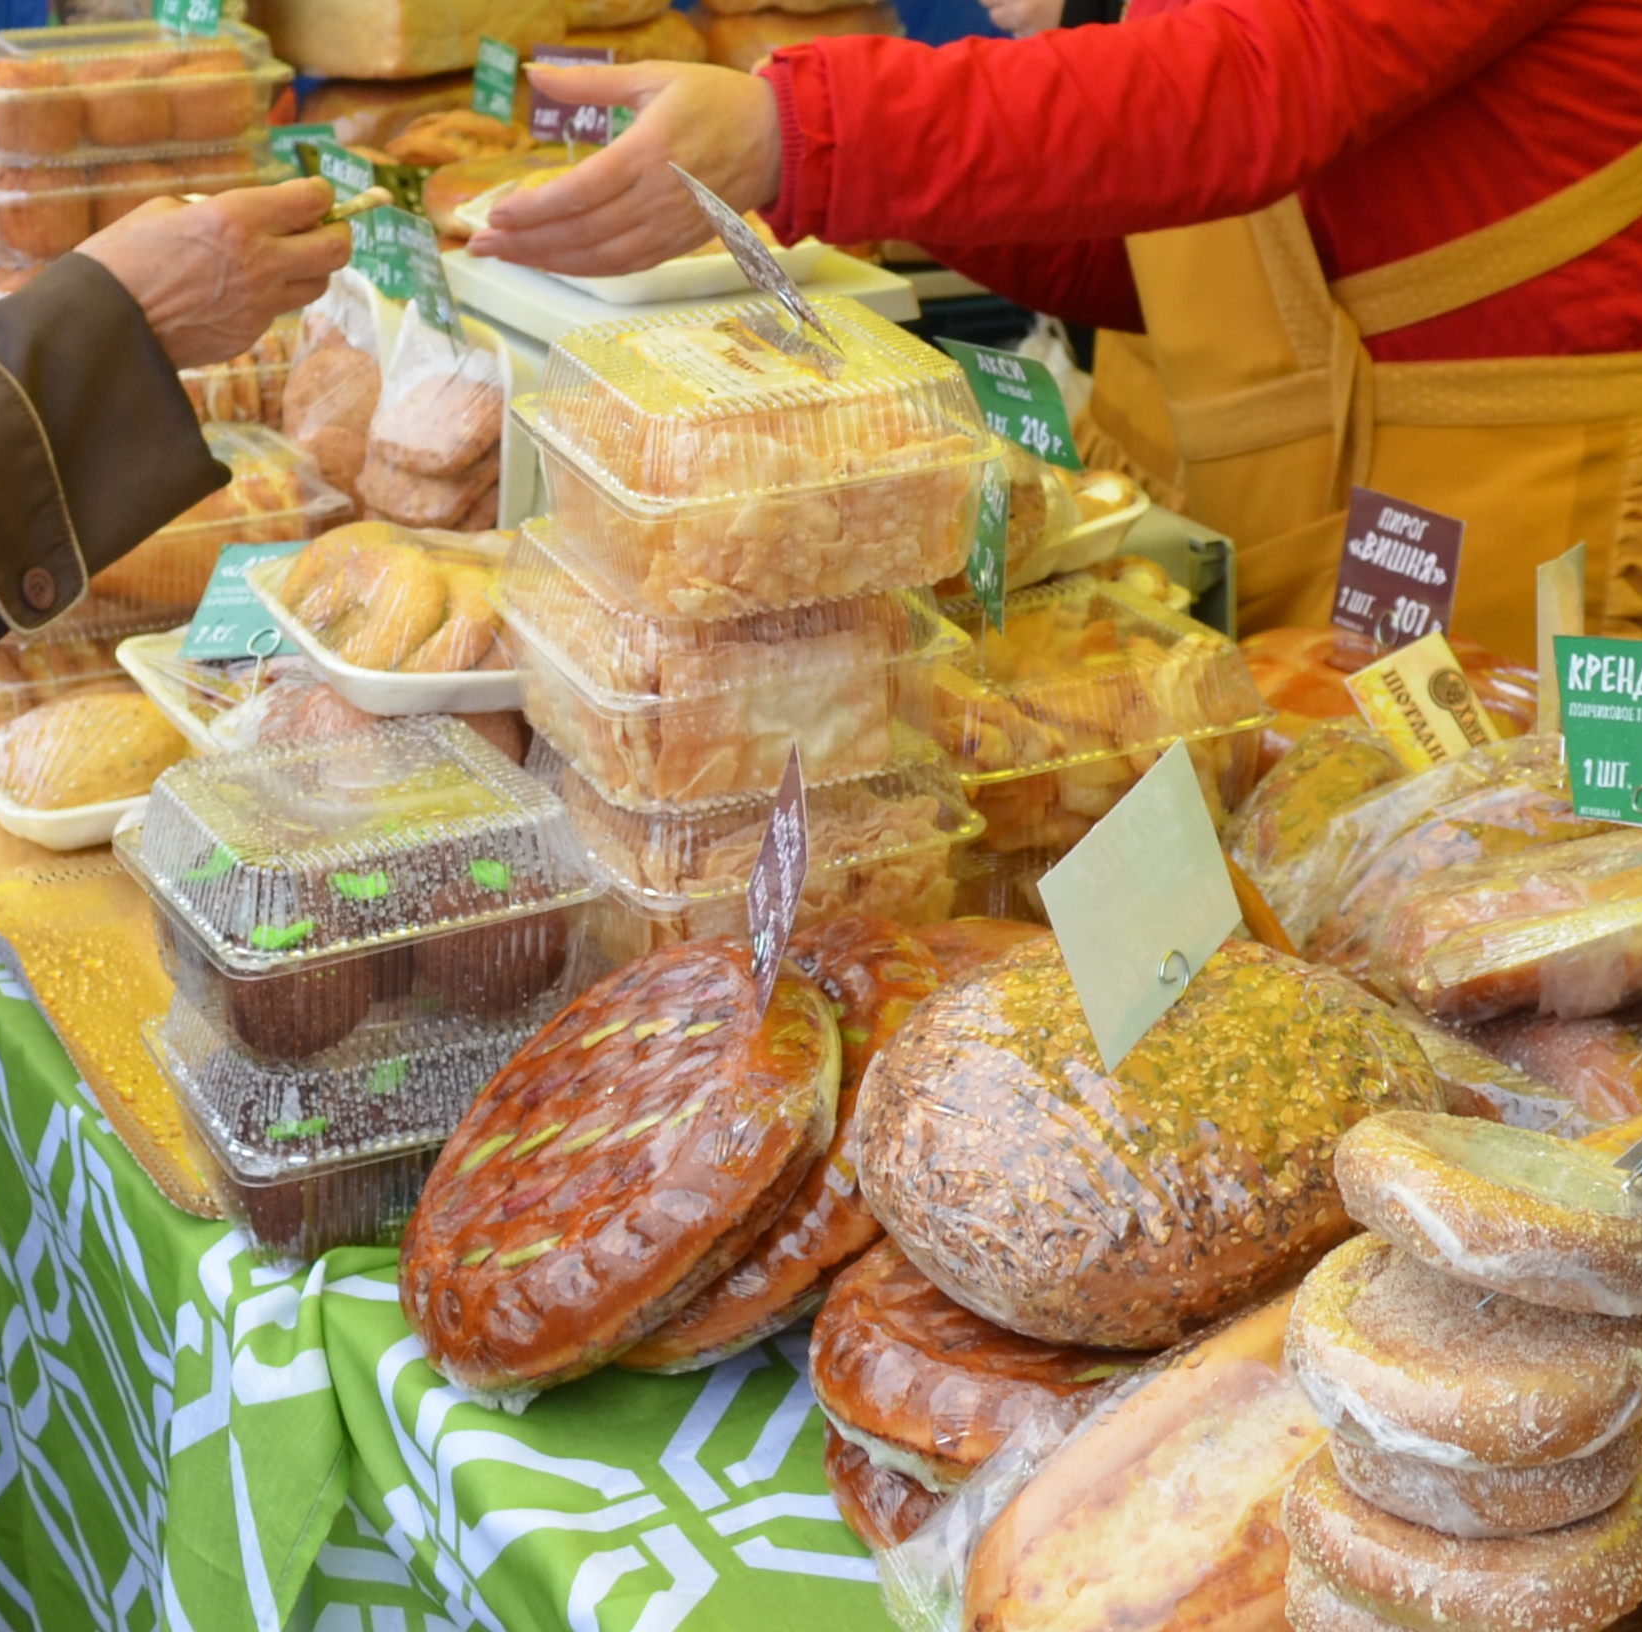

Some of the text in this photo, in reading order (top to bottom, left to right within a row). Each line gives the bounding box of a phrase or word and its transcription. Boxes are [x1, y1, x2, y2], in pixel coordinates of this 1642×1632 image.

[976, 351, 1027, 383] АКСИ
[1020, 415, 1050, 453] 216
[1377, 506, 1430, 542] ПИРОГ
[1347, 530, 1447, 586] «ВИШНЯ»
[1338, 586, 1350, 608] 1
[1394, 595, 1430, 637] 107
[1381, 668, 1448, 762] ШОТЛАН
[1569, 701, 1634, 723] ПОНЧИКОВОЕ
[1583, 758, 1593, 786] 1
[1596, 759, 1633, 790] ШТ.
